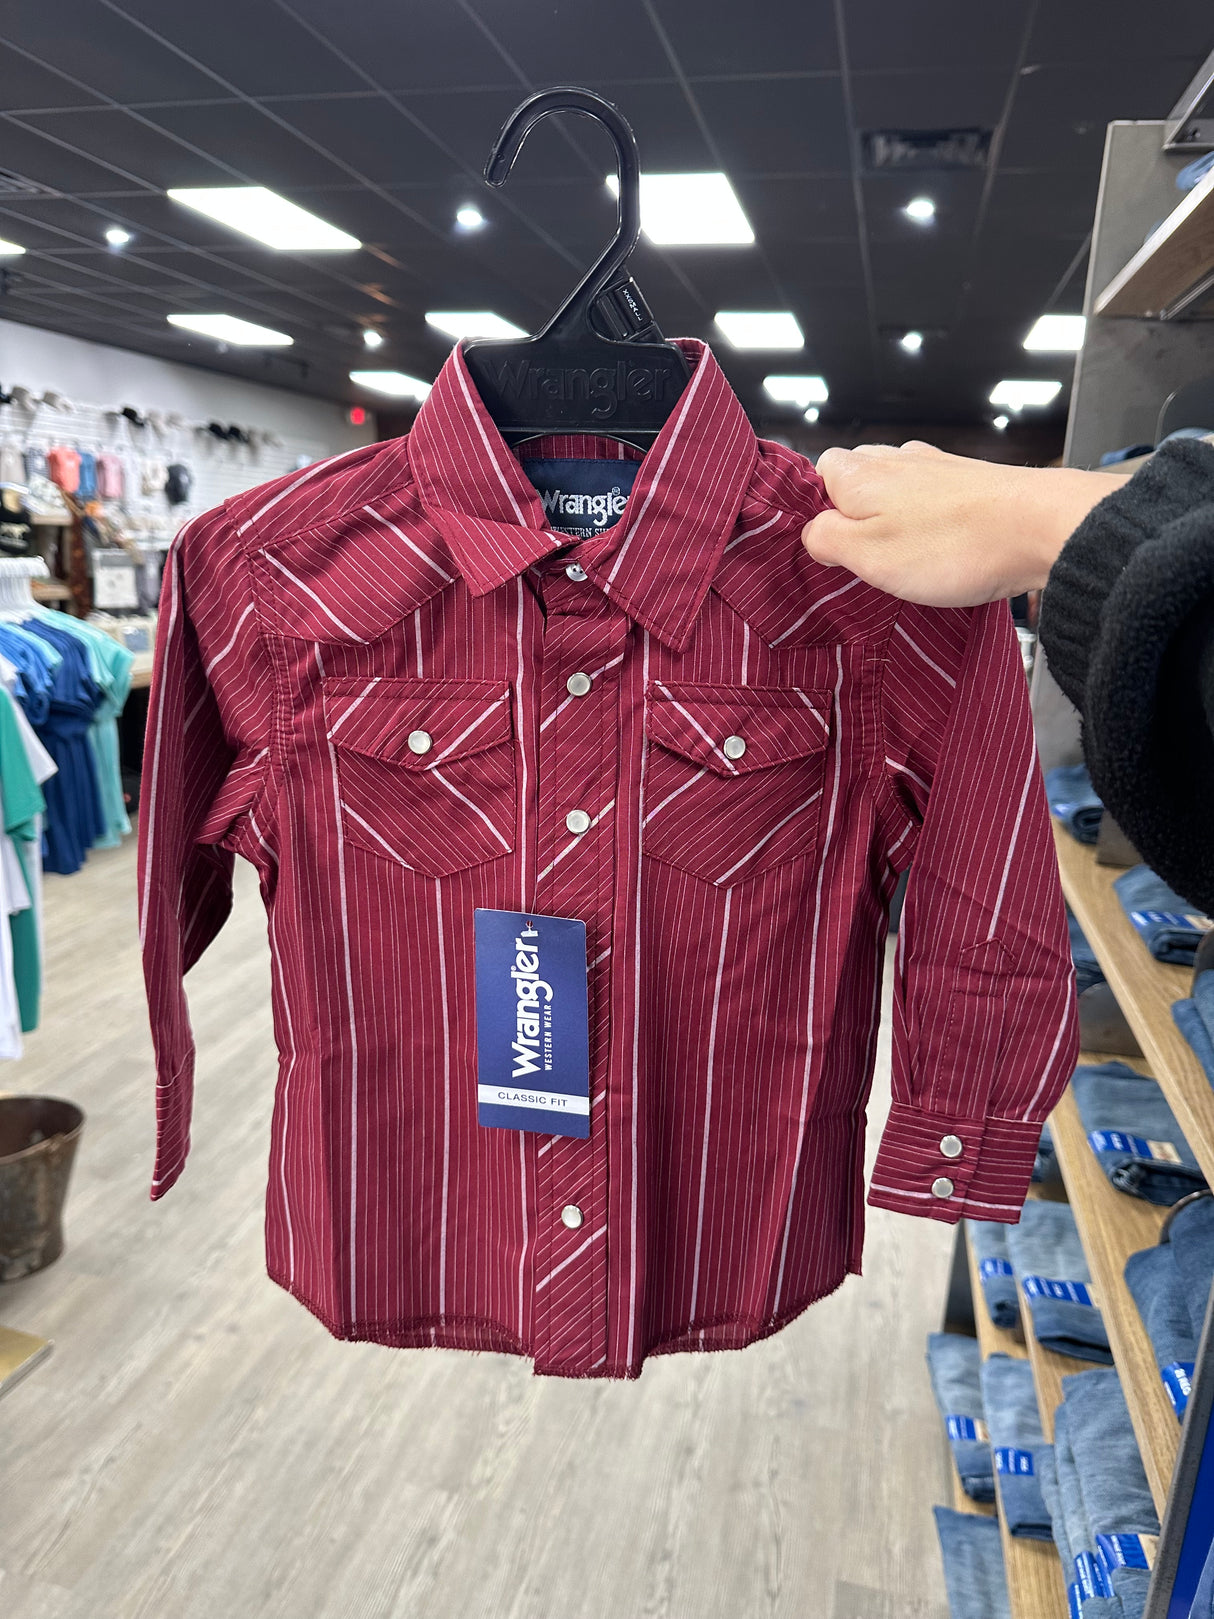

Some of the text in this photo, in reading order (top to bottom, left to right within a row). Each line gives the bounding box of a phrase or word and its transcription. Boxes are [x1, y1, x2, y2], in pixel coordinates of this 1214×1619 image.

[481, 359, 671, 420] Wrangler
[536, 489, 630, 526] Wrangle
[511, 937, 554, 1078] Wrangler
[543, 1004, 553, 1071] WESTERN WEAR
[497, 1091, 568, 1107] CLASSIC FIT
